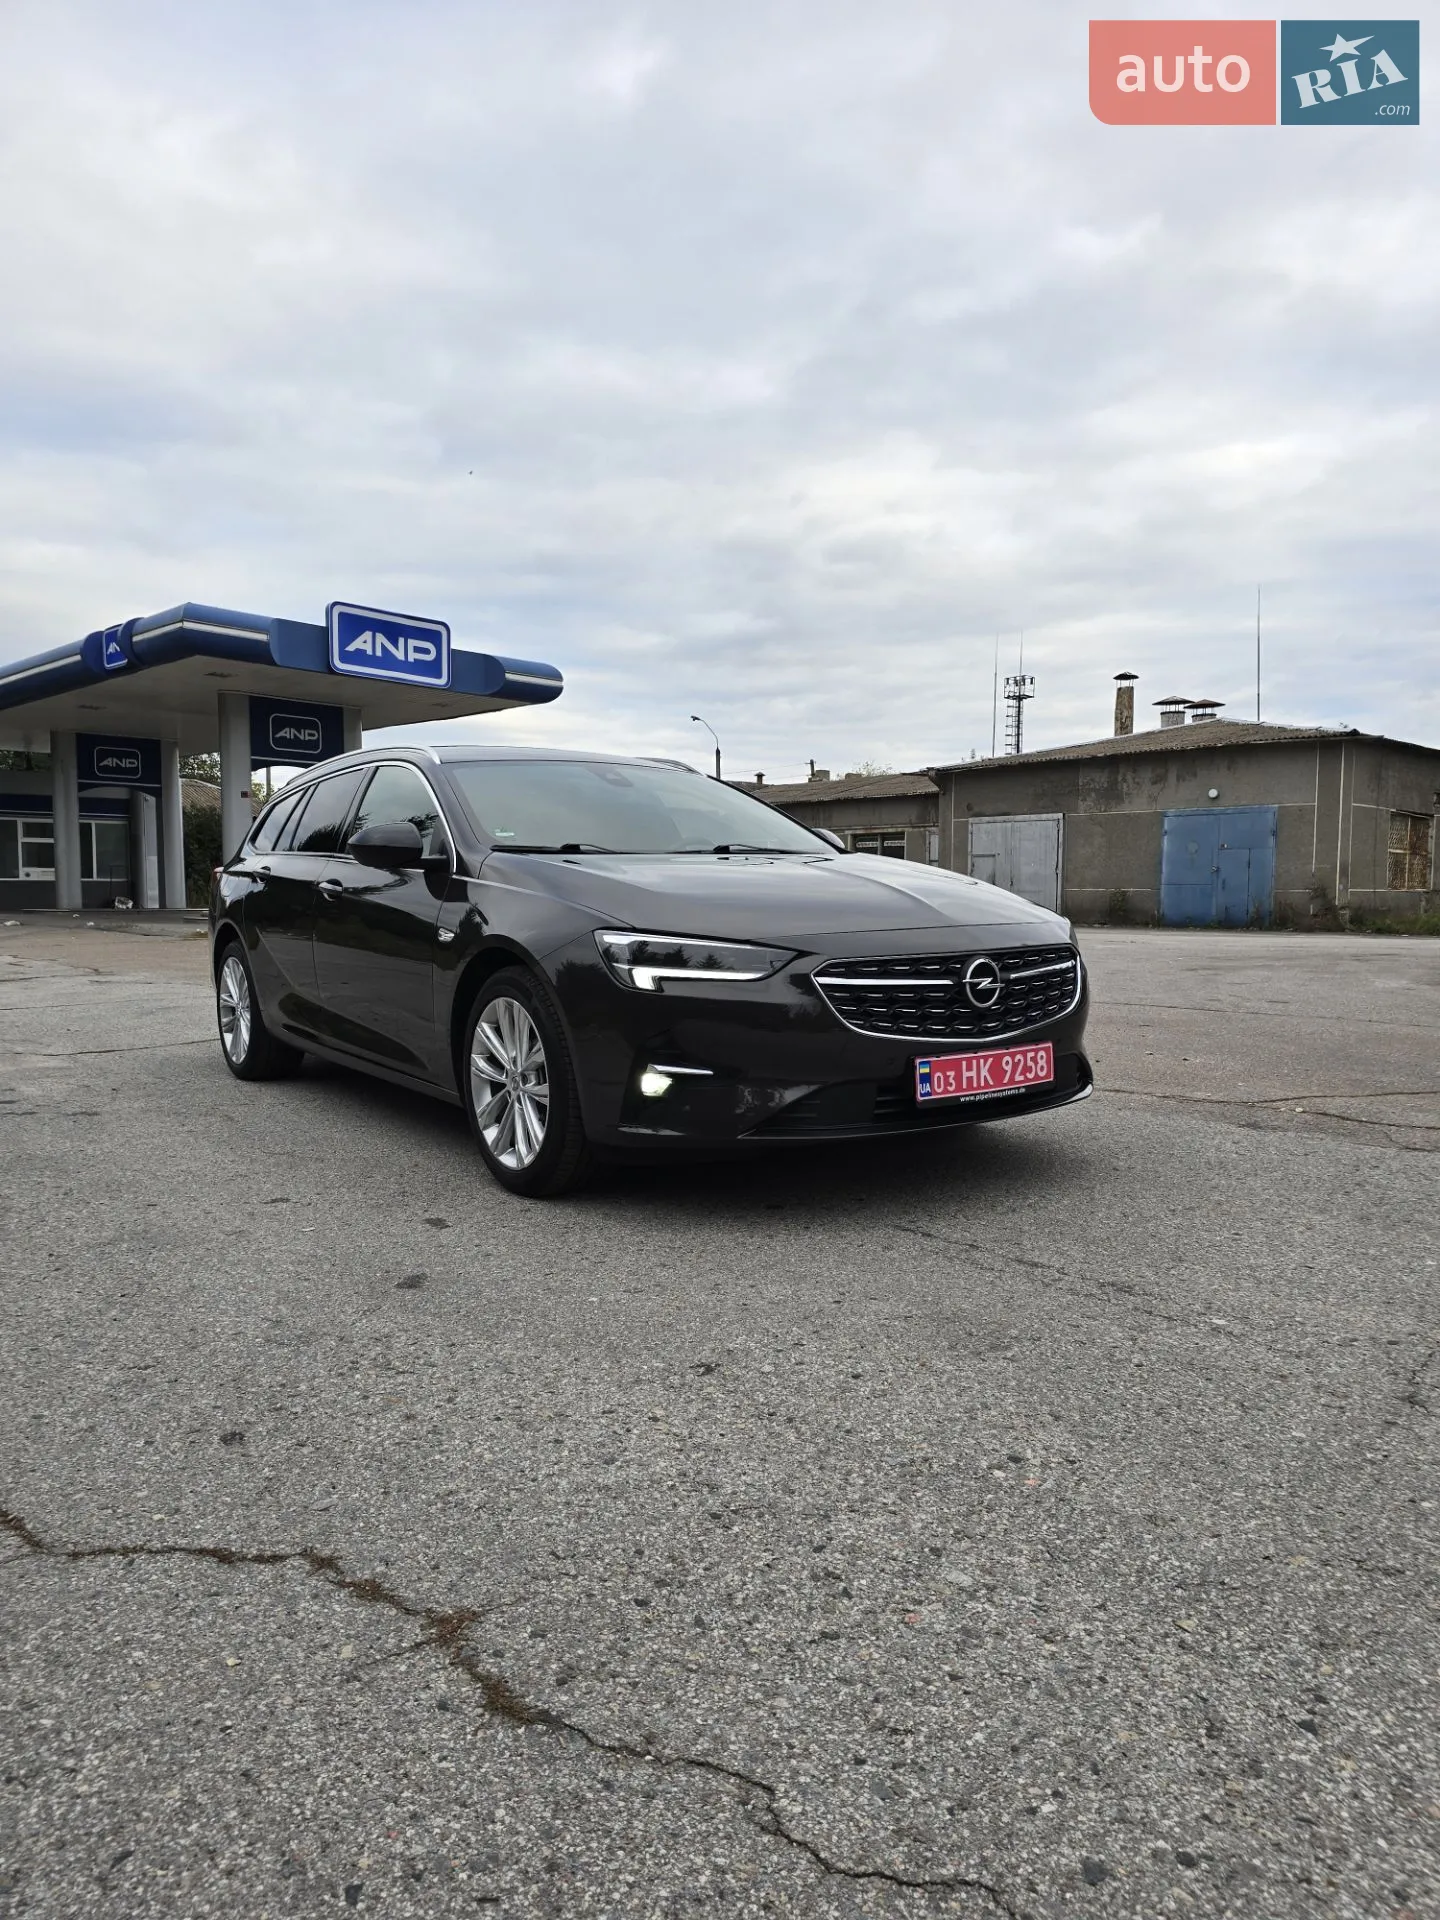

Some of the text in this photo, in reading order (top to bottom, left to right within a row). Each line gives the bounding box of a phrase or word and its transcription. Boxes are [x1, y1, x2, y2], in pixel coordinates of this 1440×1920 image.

[344, 630, 437, 663] ANP
[274, 727, 319, 741] ANP
[99, 757, 138, 768] ANP
[933, 1050, 1048, 1093] 03 HK 9258
[919, 1083, 931, 1094] UA
